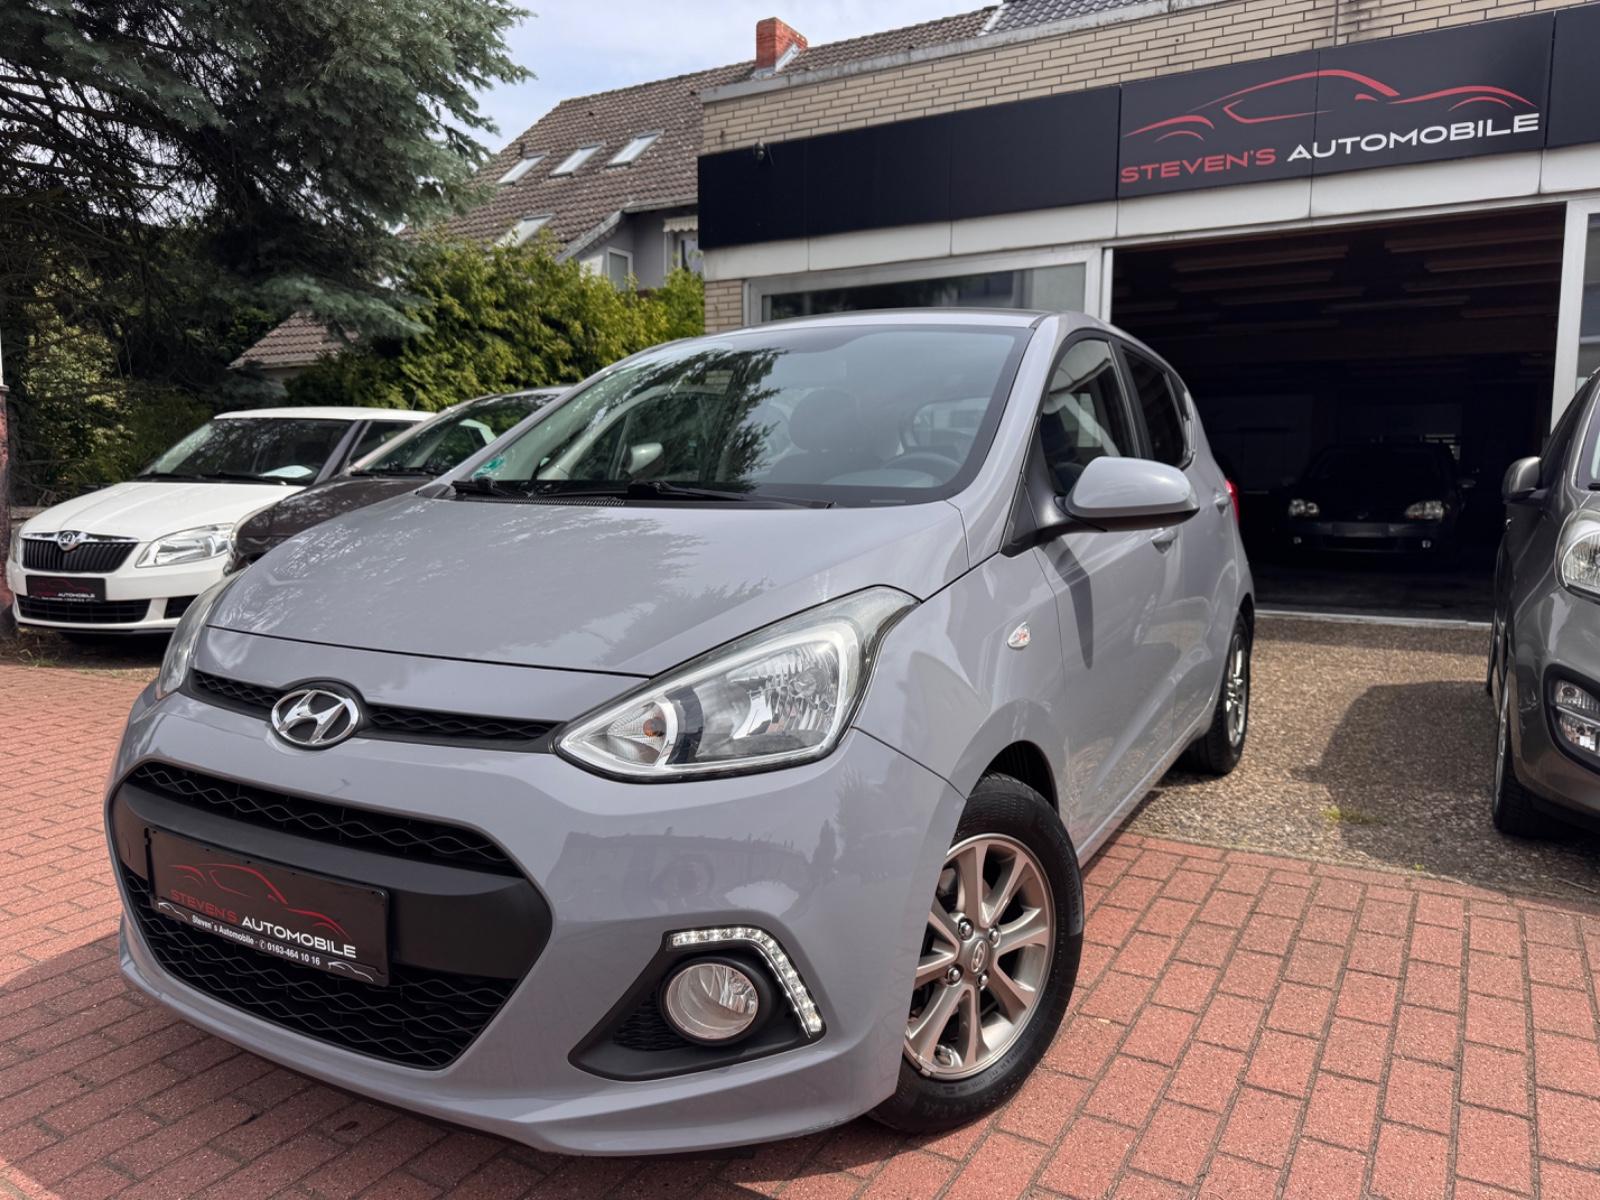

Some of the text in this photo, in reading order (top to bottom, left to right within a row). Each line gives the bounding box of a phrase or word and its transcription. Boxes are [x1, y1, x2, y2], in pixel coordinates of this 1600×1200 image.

[1120, 112, 1541, 184] STEVEN'S AUTOMOBILE
[219, 926, 255, 945] Automobile
[301, 952, 310, 963] 10
[311, 956, 320, 966] 16
[241, 915, 357, 959] AUTOMOBILE
